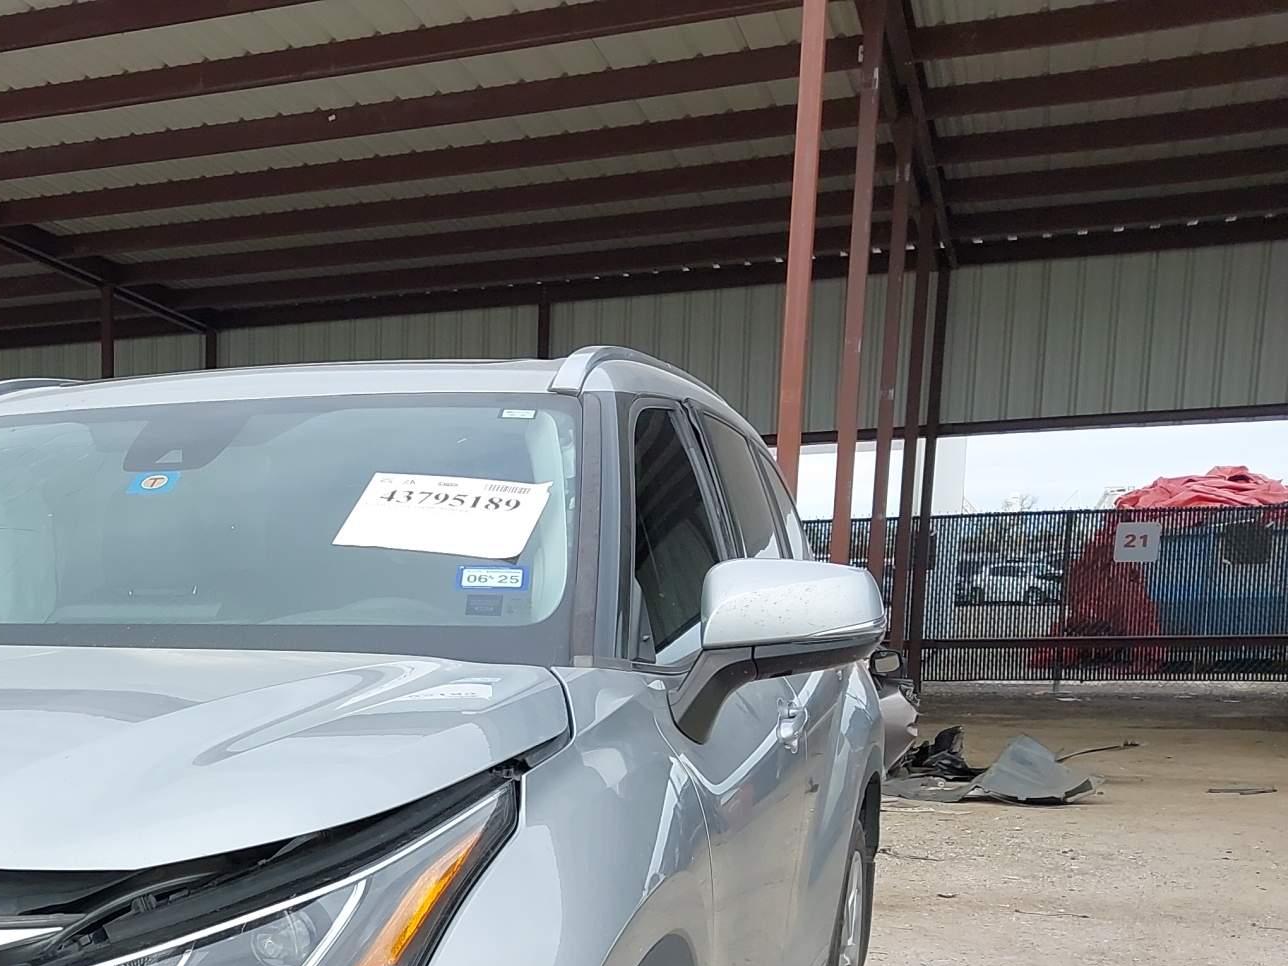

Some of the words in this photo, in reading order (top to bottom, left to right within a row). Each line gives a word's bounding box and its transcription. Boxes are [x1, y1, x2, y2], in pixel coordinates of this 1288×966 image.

[380, 489, 521, 511] 43795189
[1123, 534, 1149, 548] 21
[466, 574, 488, 584] 06
[497, 574, 520, 584] 25
